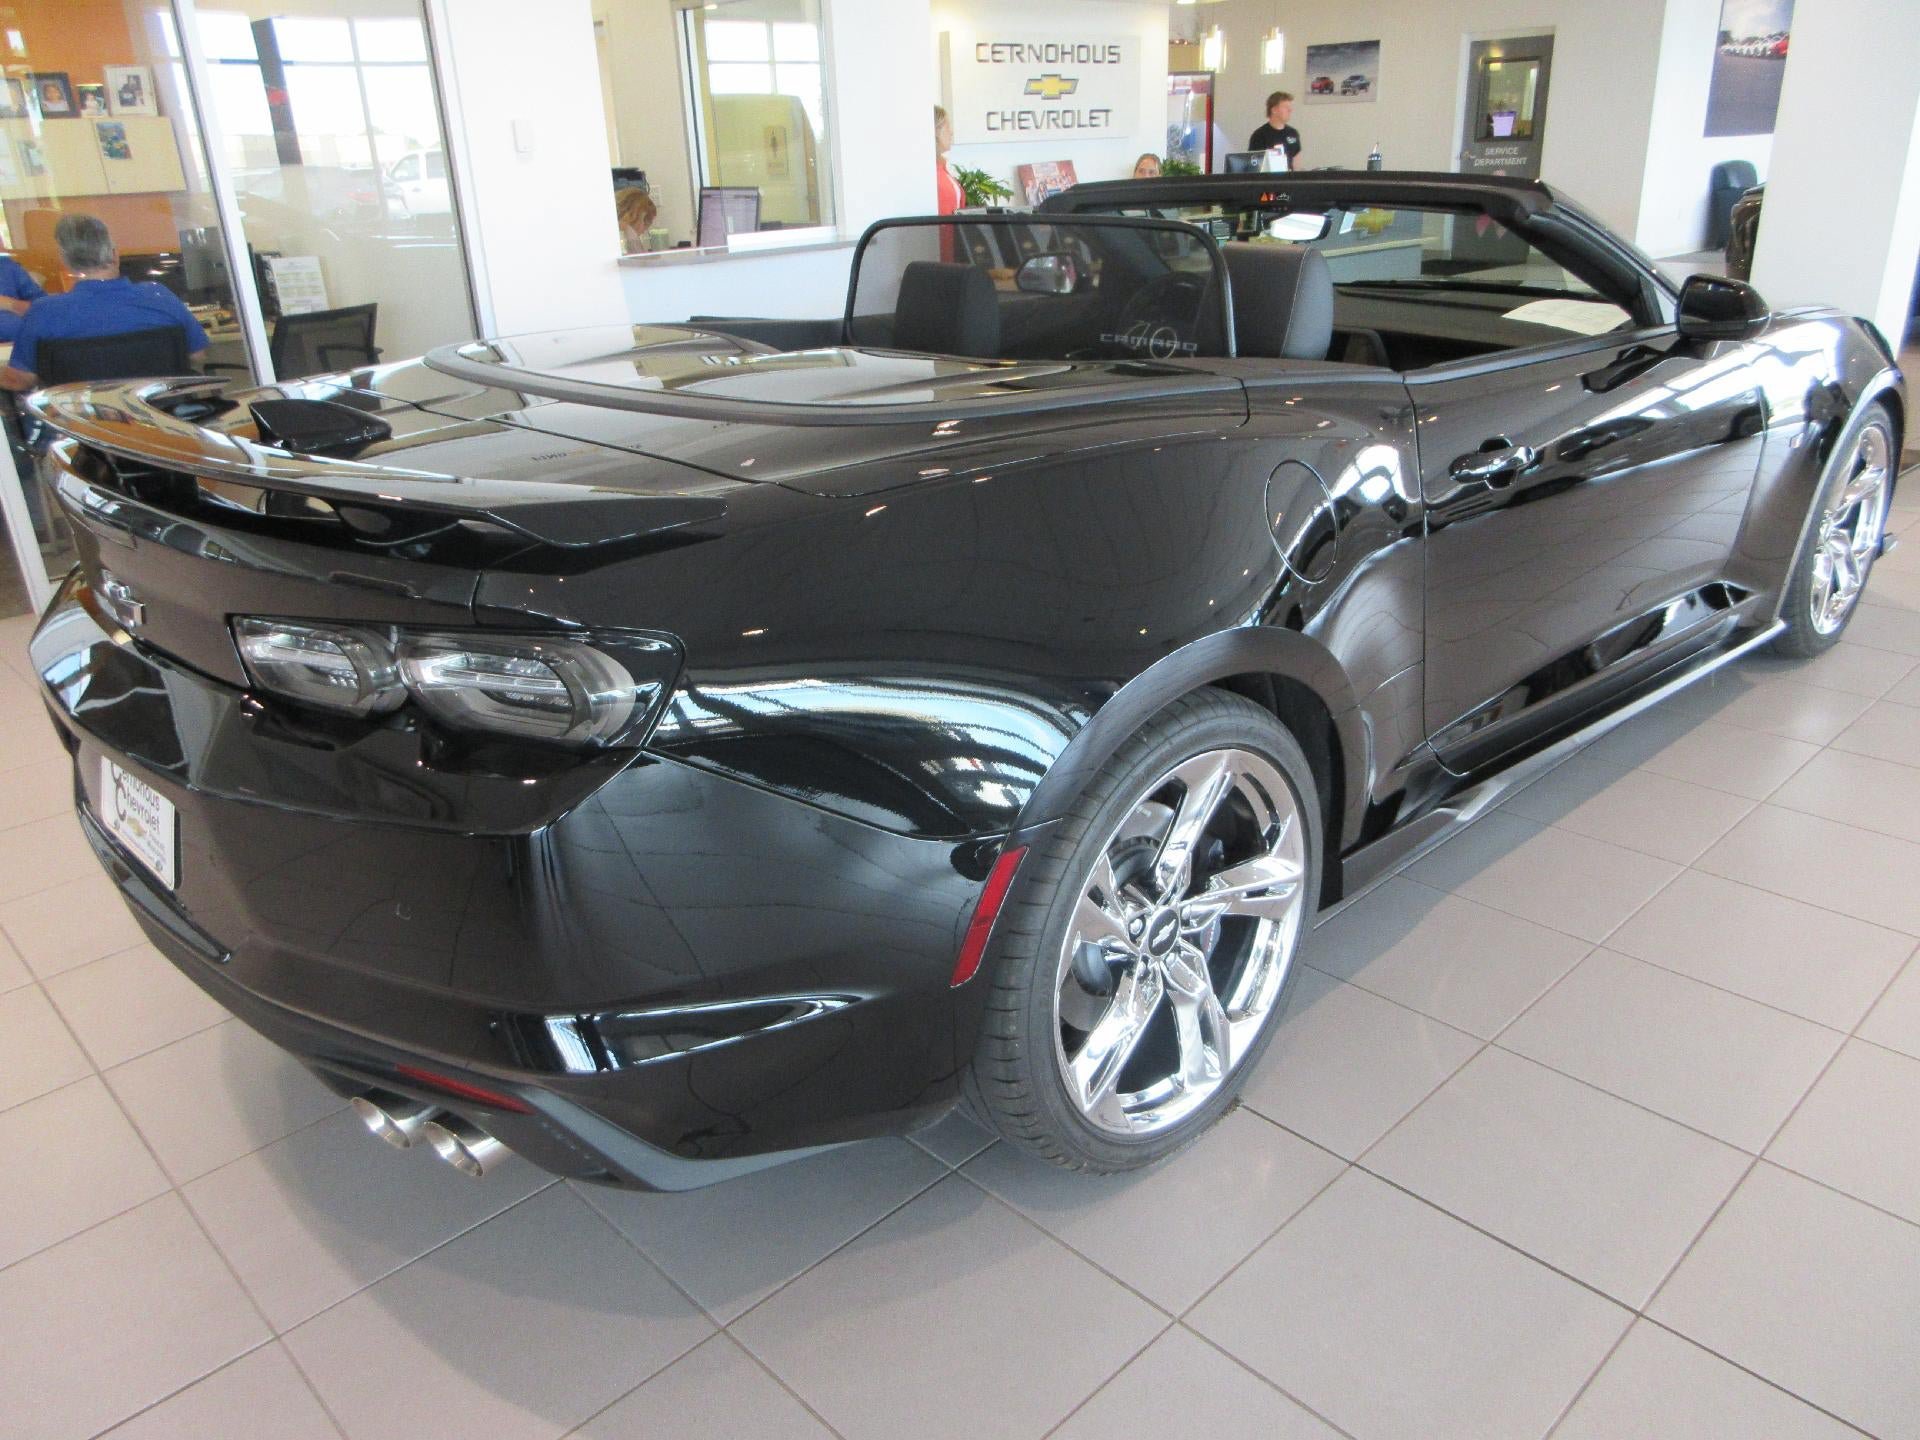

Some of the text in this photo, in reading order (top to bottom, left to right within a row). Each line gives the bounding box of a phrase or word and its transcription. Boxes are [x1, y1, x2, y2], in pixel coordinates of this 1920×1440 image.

[976, 42, 1121, 64] CERNOHOUS
[986, 109, 1112, 131] CHEVROLET
[1485, 147, 1519, 156] SERVICE
[1474, 157, 1527, 167] DEPARTMENT
[1100, 333, 1198, 352] CAMARO
[116, 785, 160, 834] Chevrolet
